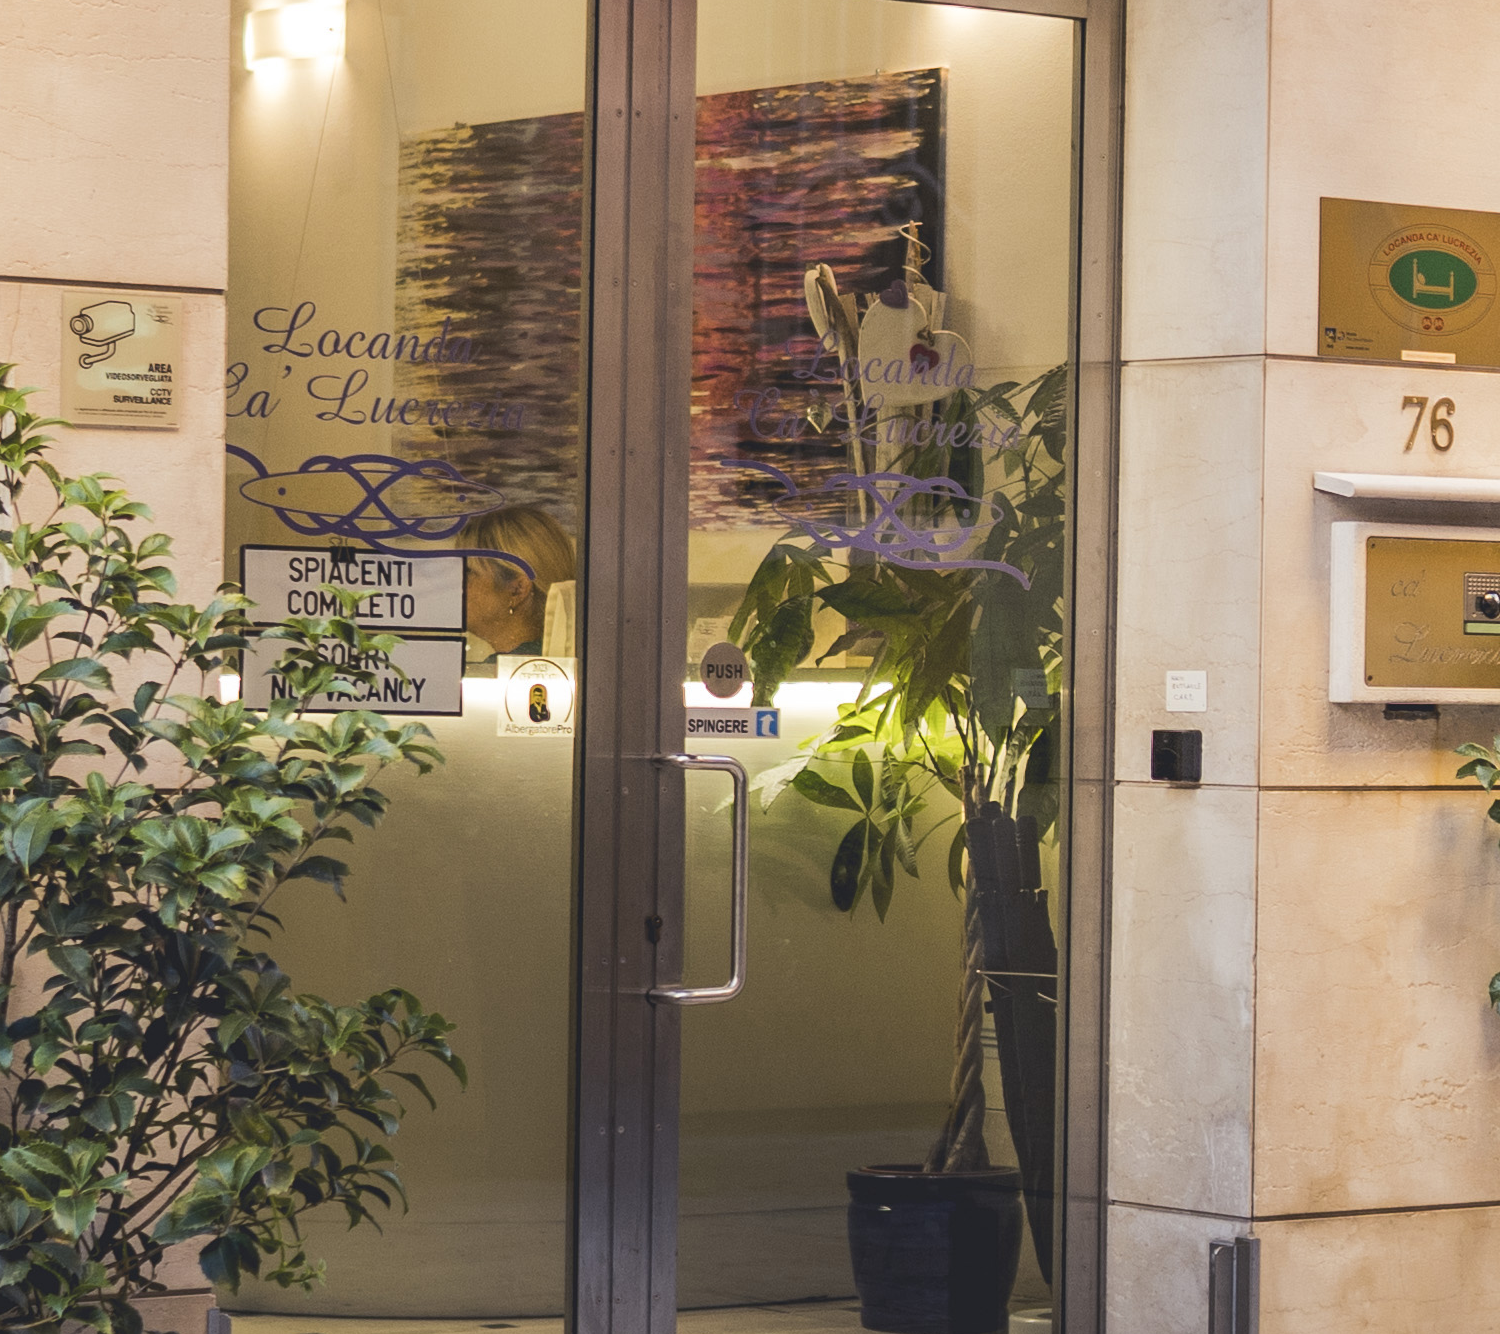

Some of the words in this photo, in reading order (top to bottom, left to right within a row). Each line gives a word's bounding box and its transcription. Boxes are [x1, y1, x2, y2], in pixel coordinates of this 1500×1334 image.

[1383, 233, 1425, 256] LOCANDA
[1442, 234, 1482, 265] LUCREZIA
[253, 301, 483, 364] Locanda
[148, 363, 172, 373] AREA
[785, 330, 977, 388] Locanda
[105, 372, 172, 382] VIDEOSORVEGLIATA
[149, 388, 172, 396] CCTV
[113, 395, 172, 405] SURVEILLANCE
[307, 369, 528, 431] Lucrezia
[831, 392, 1023, 451] Lucrezia
[1401, 395, 1456, 452] 76
[289, 557, 413, 587] SPIACENTI
[706, 663, 743, 679] PUSH
[687, 718, 749, 734] SPINGERE
